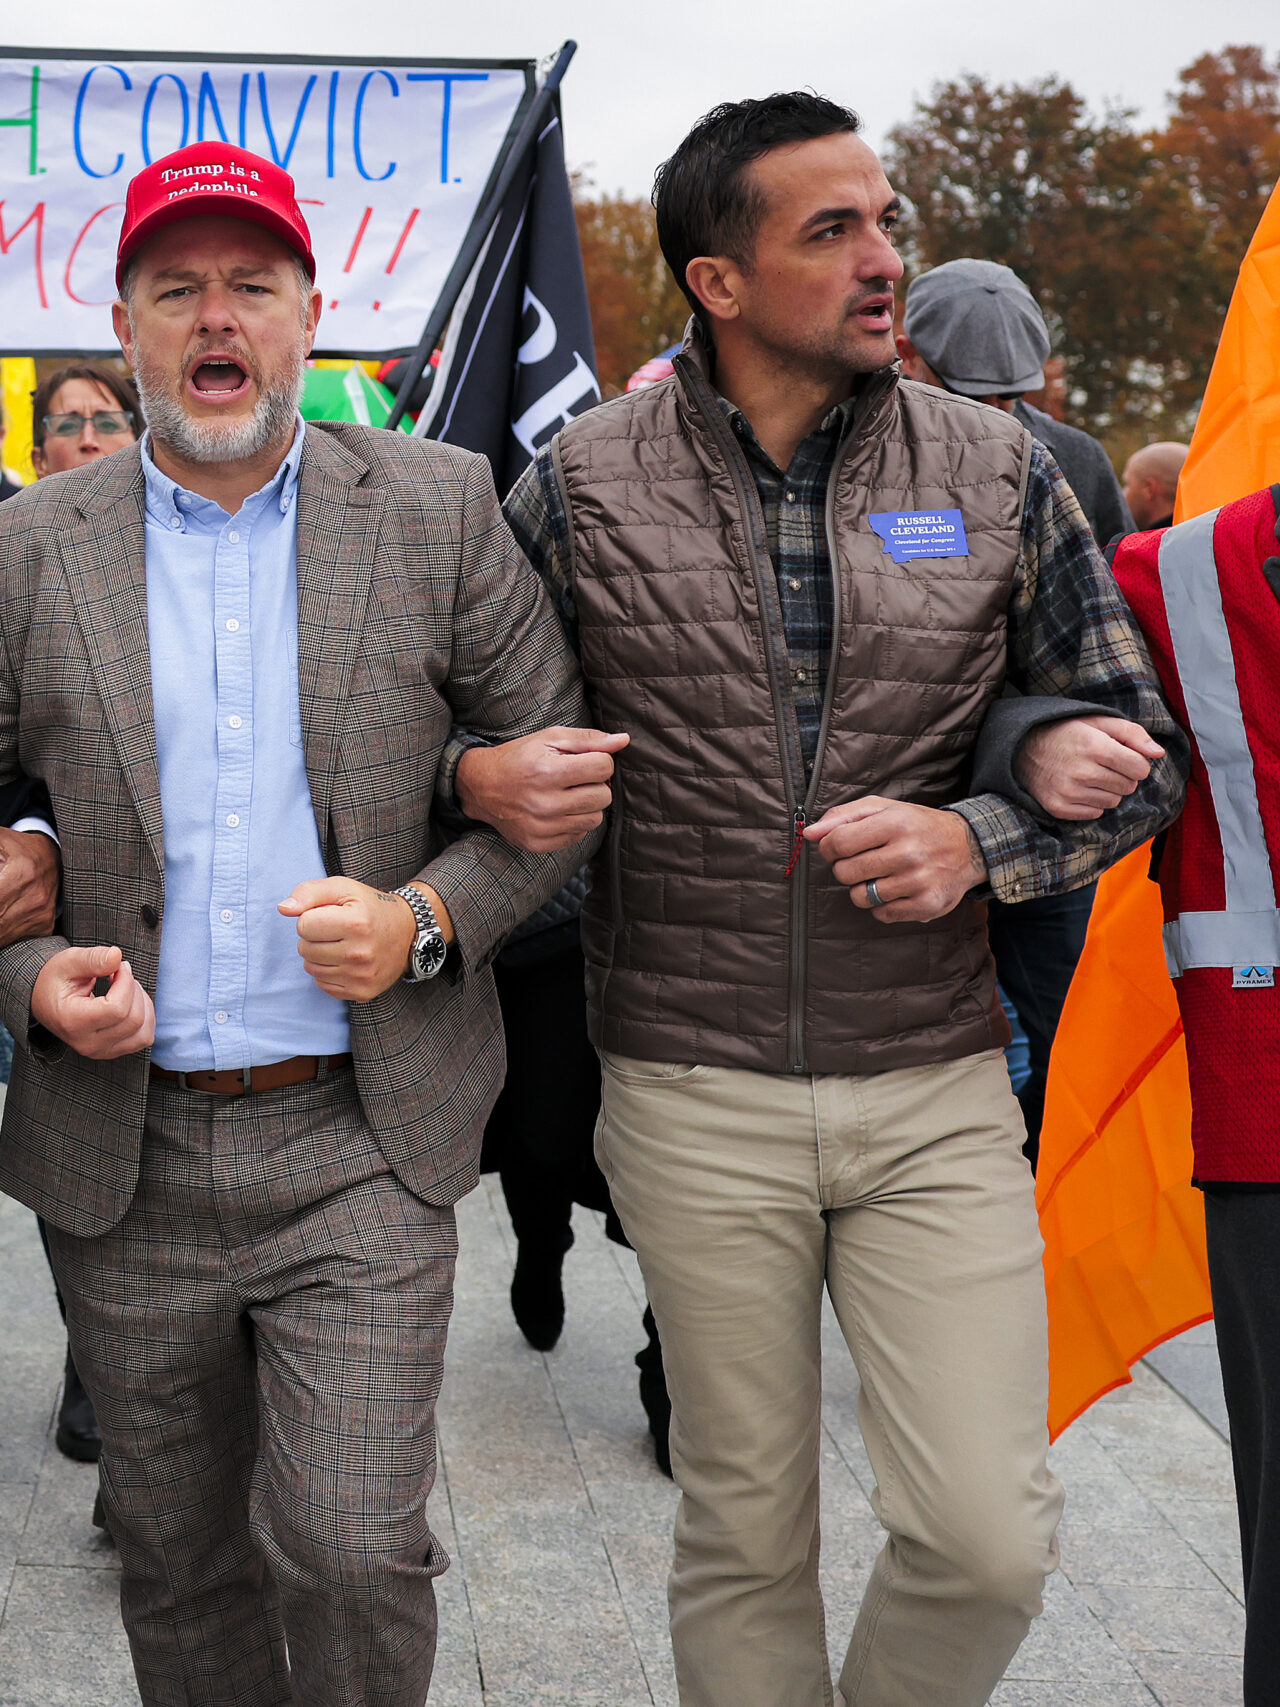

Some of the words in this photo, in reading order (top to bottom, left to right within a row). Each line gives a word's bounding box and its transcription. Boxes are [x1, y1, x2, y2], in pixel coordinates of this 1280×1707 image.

[73, 64, 490, 184] CONVICT.
[160, 163, 224, 184] Trump
[229, 161, 246, 176] is
[250, 169, 263, 182] a
[167, 180, 259, 201] pedophile
[897, 516, 945, 525] RUSSELL
[890, 525, 955, 535] CLEVELAND
[921, 537, 930, 545] for
